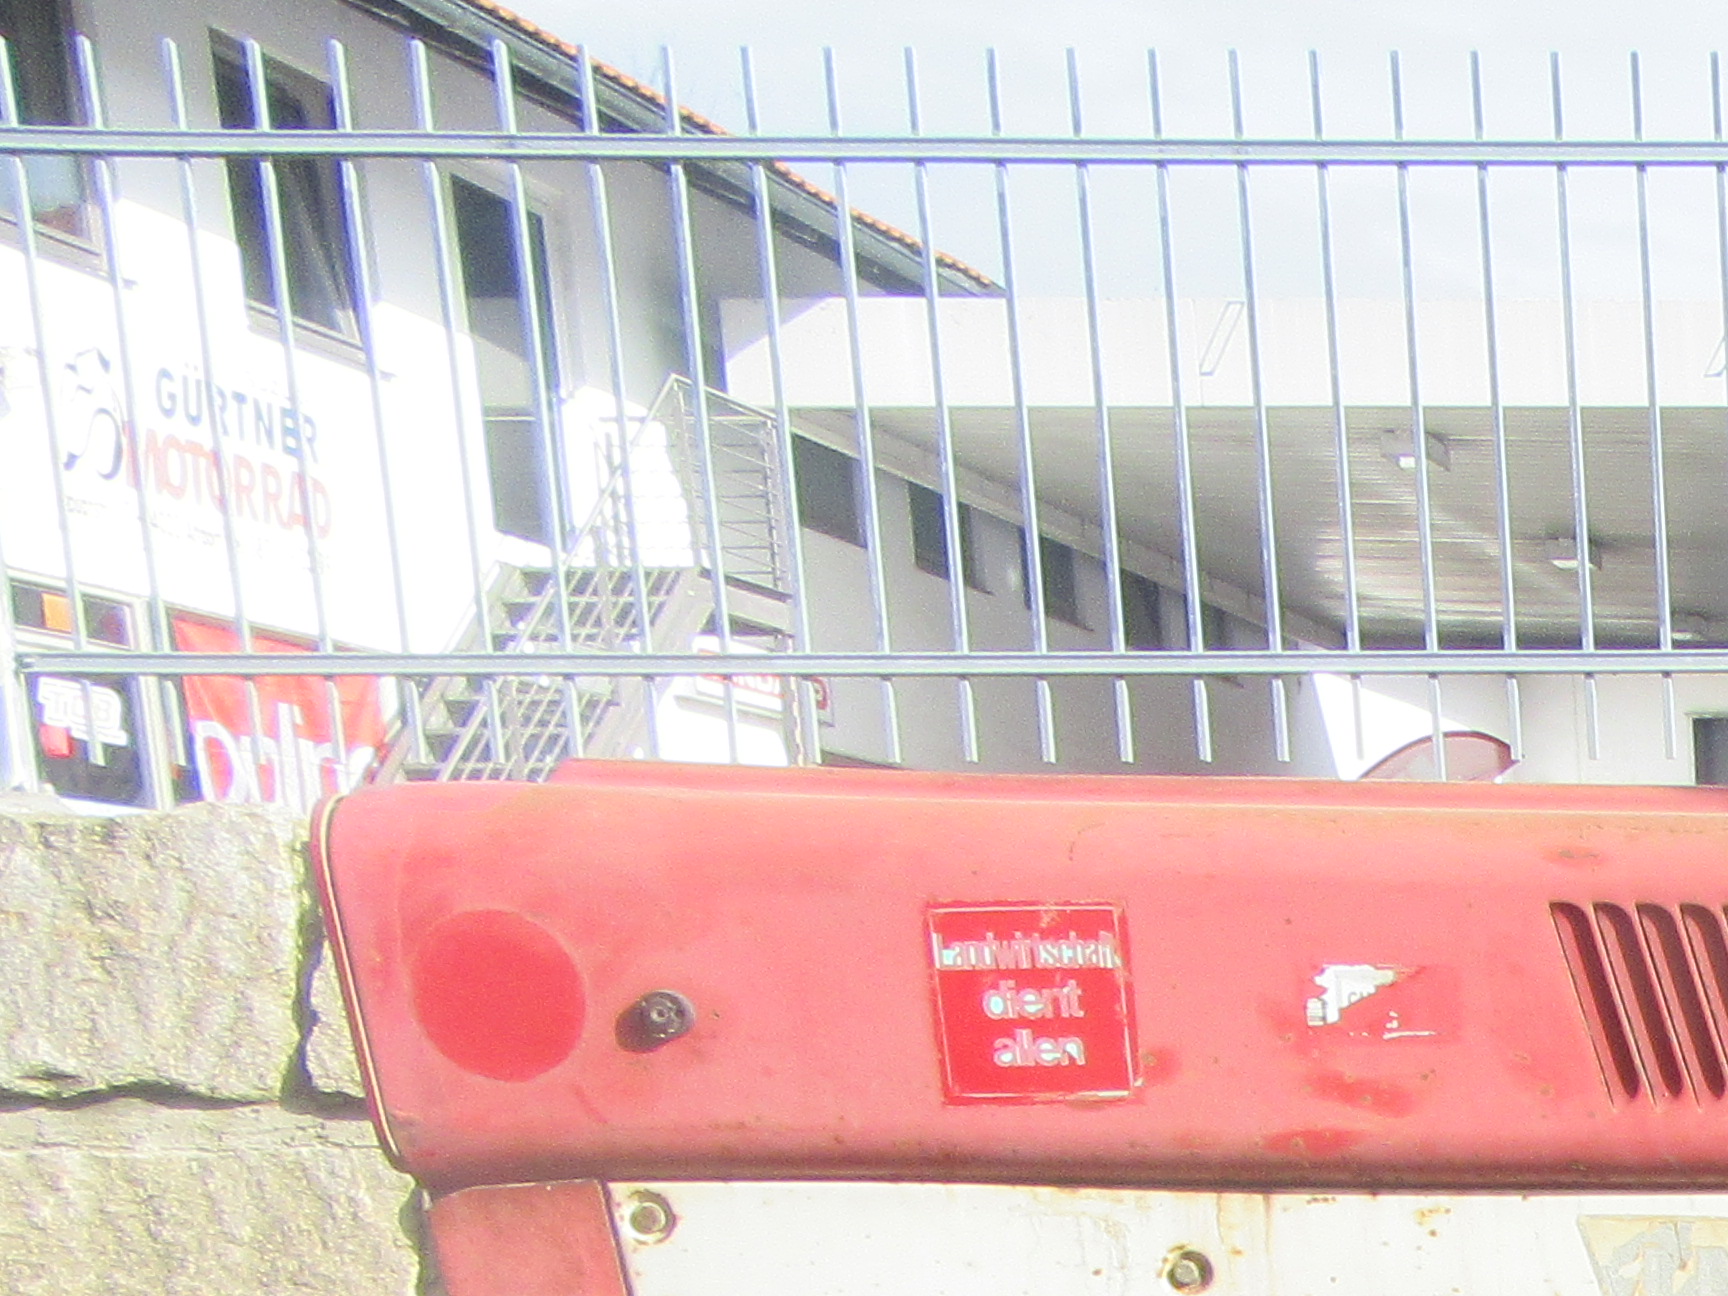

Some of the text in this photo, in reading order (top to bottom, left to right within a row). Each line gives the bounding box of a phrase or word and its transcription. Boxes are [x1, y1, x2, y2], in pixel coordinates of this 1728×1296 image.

[156, 361, 319, 464] GÜRTNER
[122, 420, 332, 540] MOTORRAD
[982, 979, 1085, 1020] dient
[992, 1027, 1087, 1067] allen
